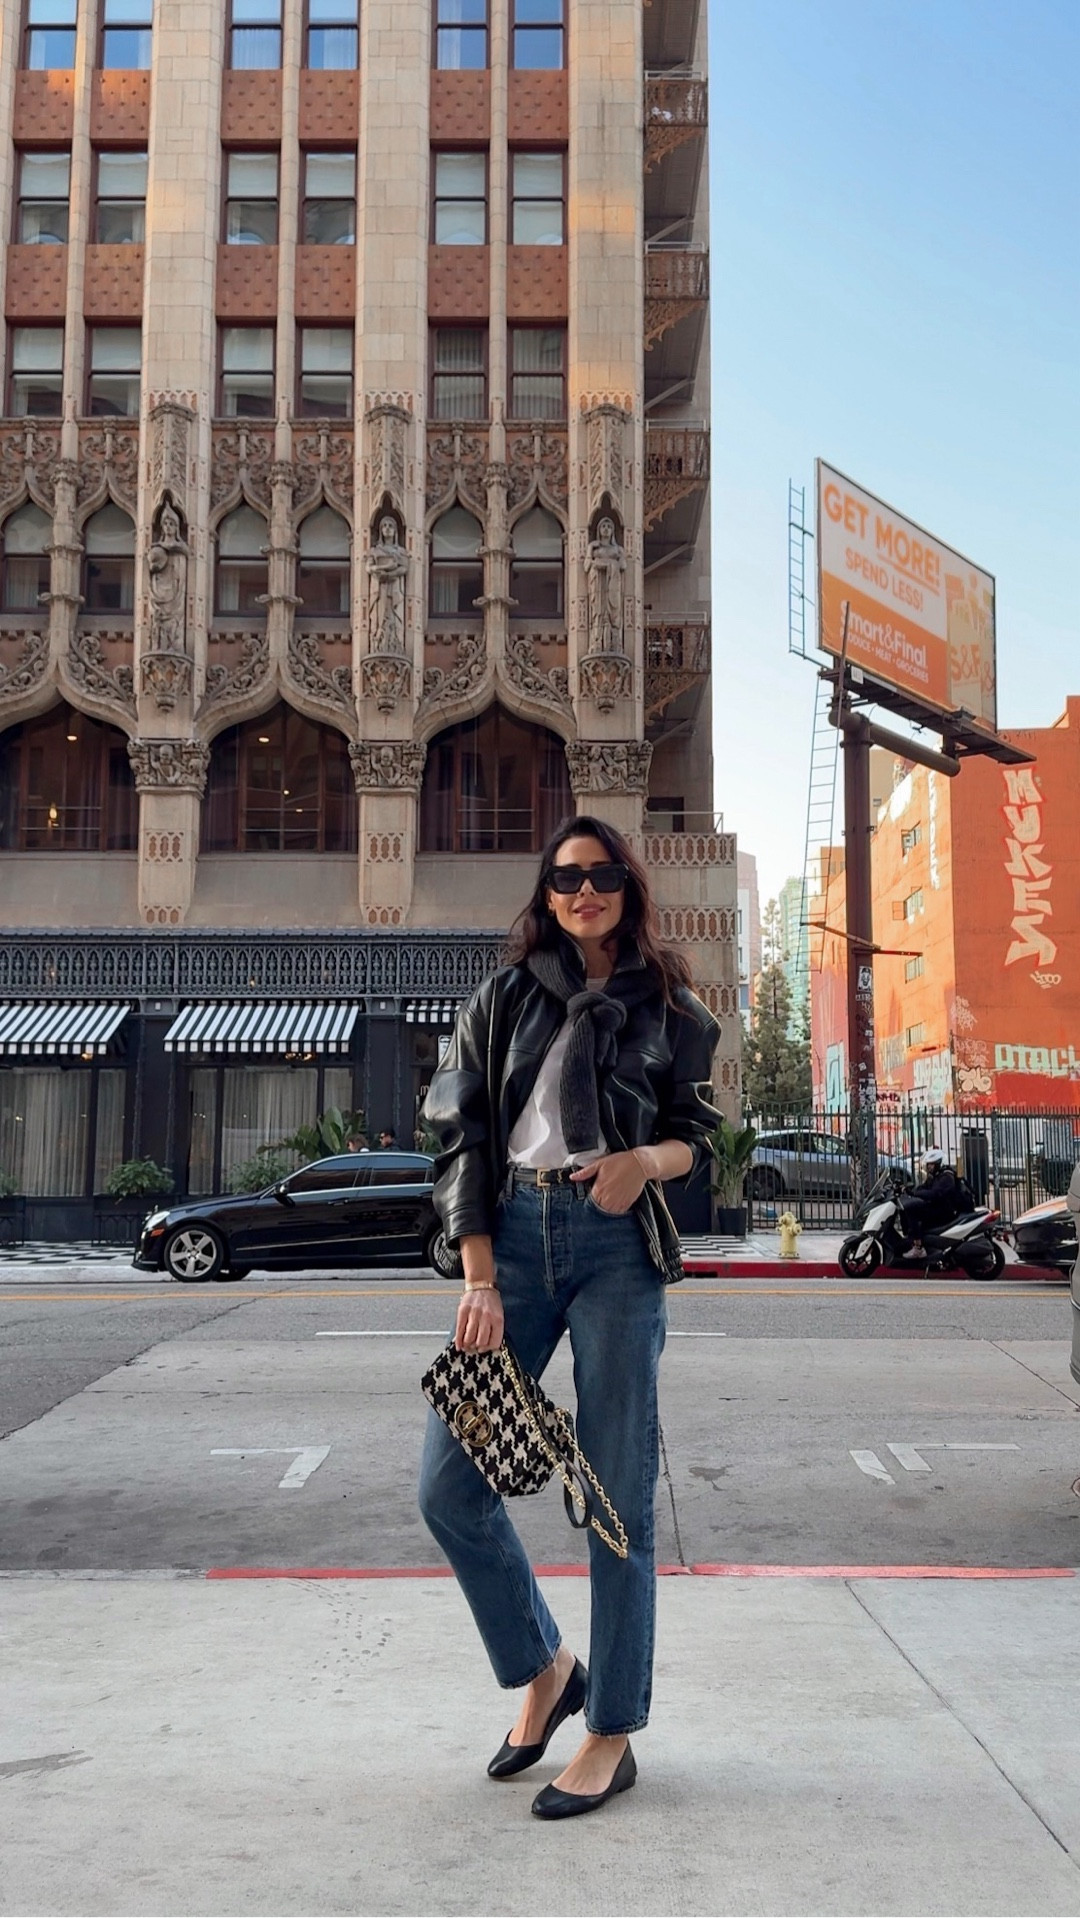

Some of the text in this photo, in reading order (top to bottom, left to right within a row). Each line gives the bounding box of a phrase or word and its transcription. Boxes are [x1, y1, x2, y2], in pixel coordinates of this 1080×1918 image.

[824, 483, 941, 587] GET MORE!
[845, 547, 923, 612] SPEND LESS!
[951, 644, 980, 682] S&F
